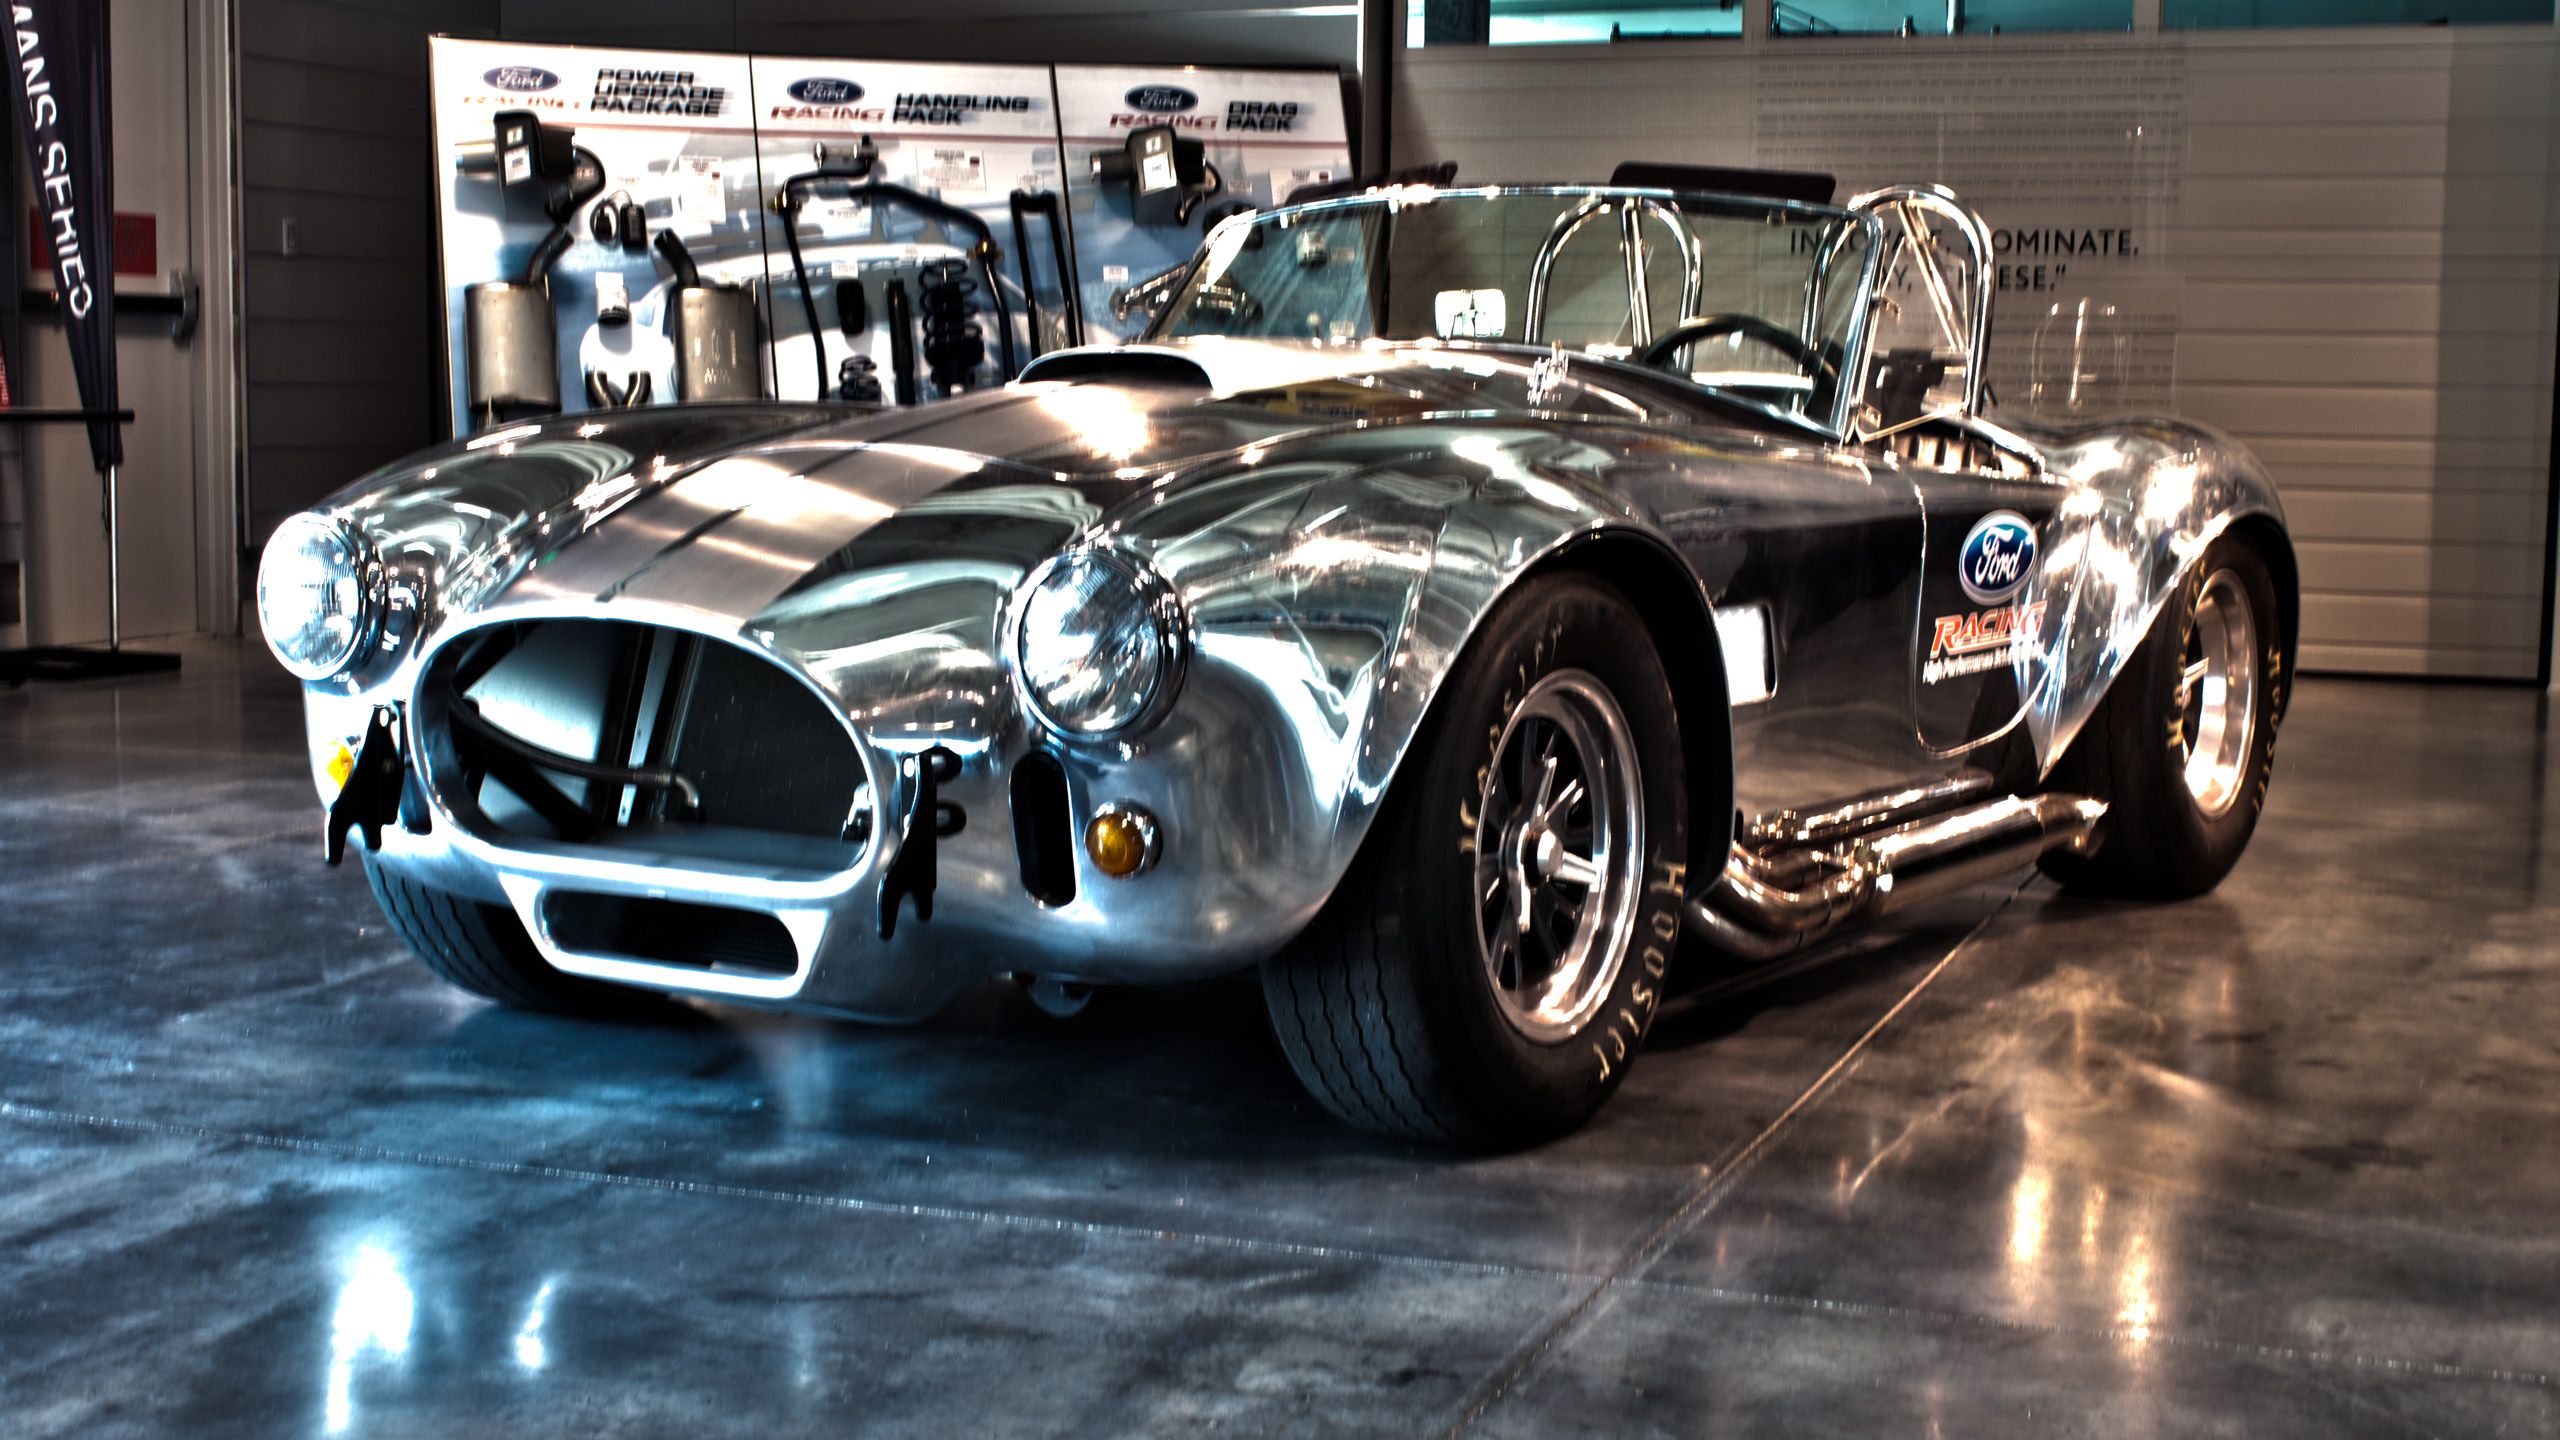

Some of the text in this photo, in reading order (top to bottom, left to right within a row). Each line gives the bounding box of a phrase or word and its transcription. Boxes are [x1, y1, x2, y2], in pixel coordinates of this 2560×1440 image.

[497, 67, 544, 90] Ford
[597, 69, 694, 84] POWER
[594, 82, 726, 100] UPGRADE
[803, 80, 848, 101] Ford
[1140, 88, 1183, 109] Ford
[590, 98, 720, 117] PACKAGE
[895, 93, 1029, 112] HANDLING
[1228, 101, 1298, 115] DRAG
[770, 106, 886, 123] RACING
[892, 109, 963, 125] PACK
[1109, 113, 1218, 130] RACING
[1226, 115, 1292, 132] PACK
[1974, 526, 2023, 585] Ford
[1929, 600, 2048, 659] RACING
